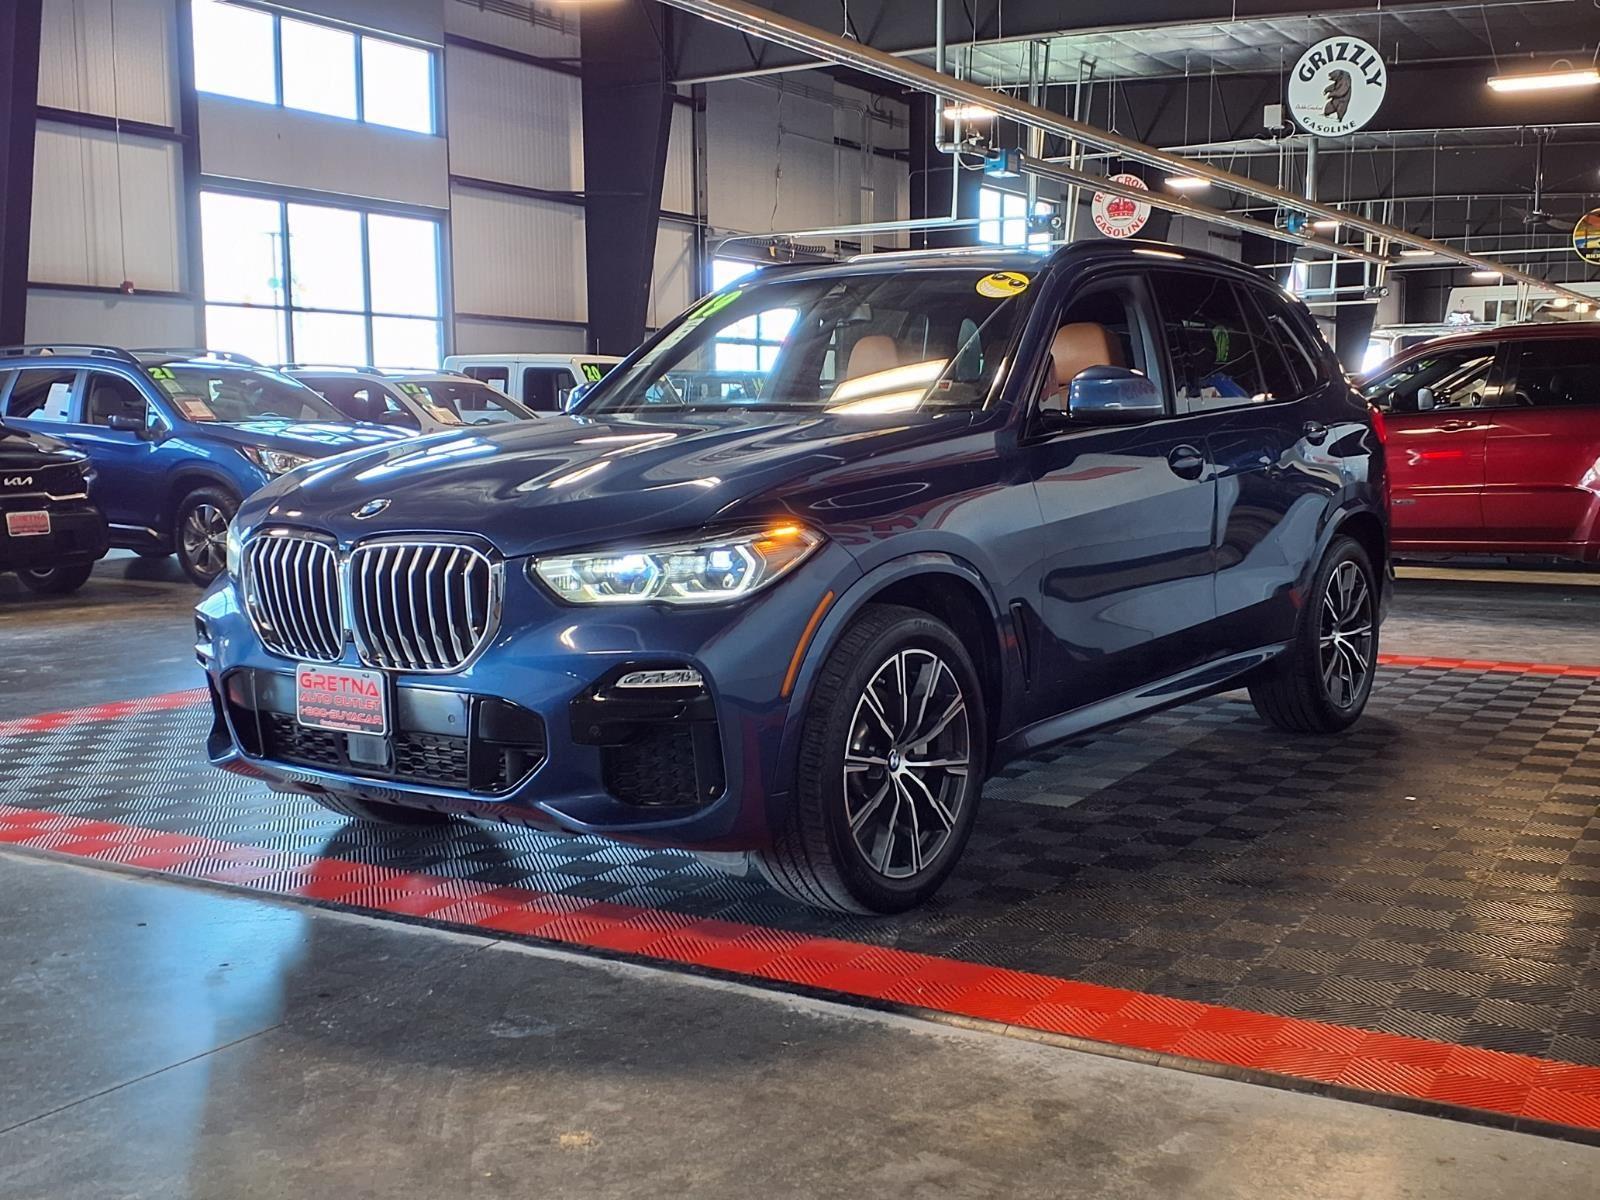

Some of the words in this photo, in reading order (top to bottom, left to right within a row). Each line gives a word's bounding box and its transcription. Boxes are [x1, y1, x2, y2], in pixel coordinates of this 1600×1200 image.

[1299, 42, 1382, 87] GRIZZLY
[1303, 117, 1357, 133] GASOLINE
[1095, 215, 1146, 237] GASOLINE
[148, 367, 176, 379] 21
[582, 365, 601, 382] 20
[4, 476, 33, 486] KIA
[300, 672, 379, 697] GRETNA
[300, 692, 332, 705] AUTO
[335, 694, 380, 711] OUTLET
